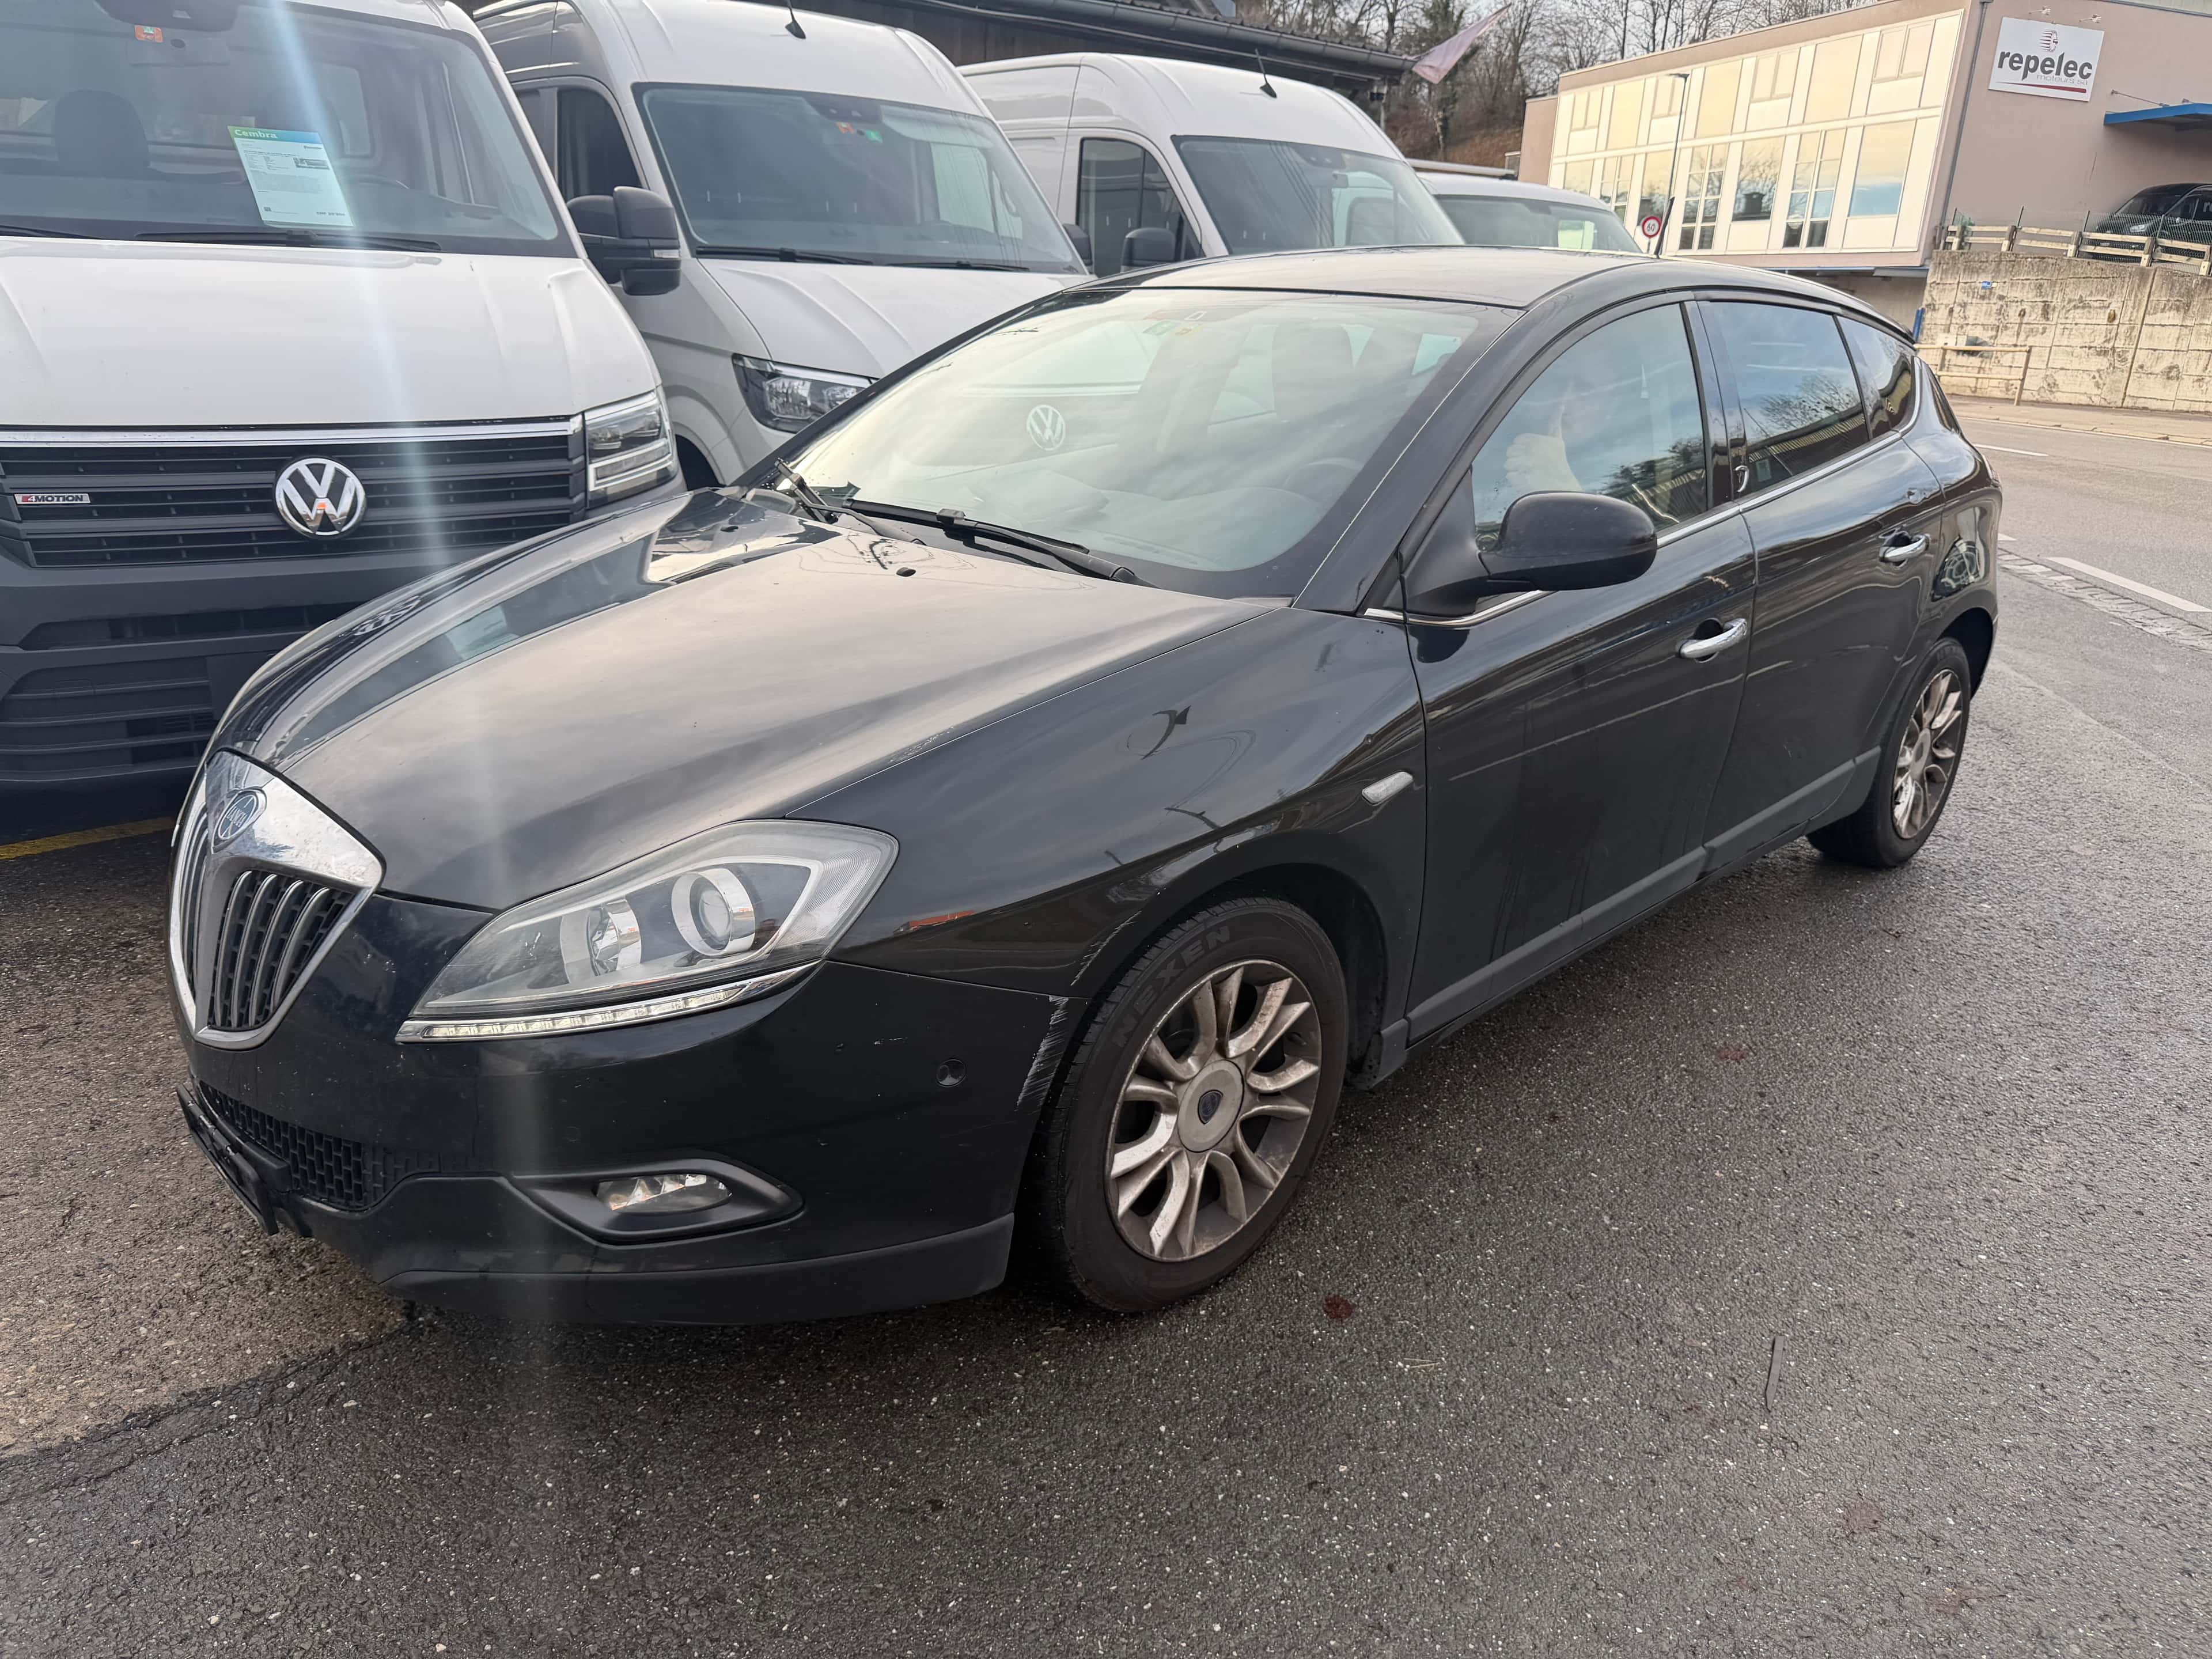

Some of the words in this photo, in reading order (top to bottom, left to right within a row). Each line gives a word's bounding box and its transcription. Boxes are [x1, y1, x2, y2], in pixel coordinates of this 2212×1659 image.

[1998, 51, 2093, 81] repelec
[234, 129, 278, 139] Cembra
[279, 459, 363, 535] VW
[226, 806, 248, 828] LANCIA
[1111, 925, 1231, 1048] NEXEN
